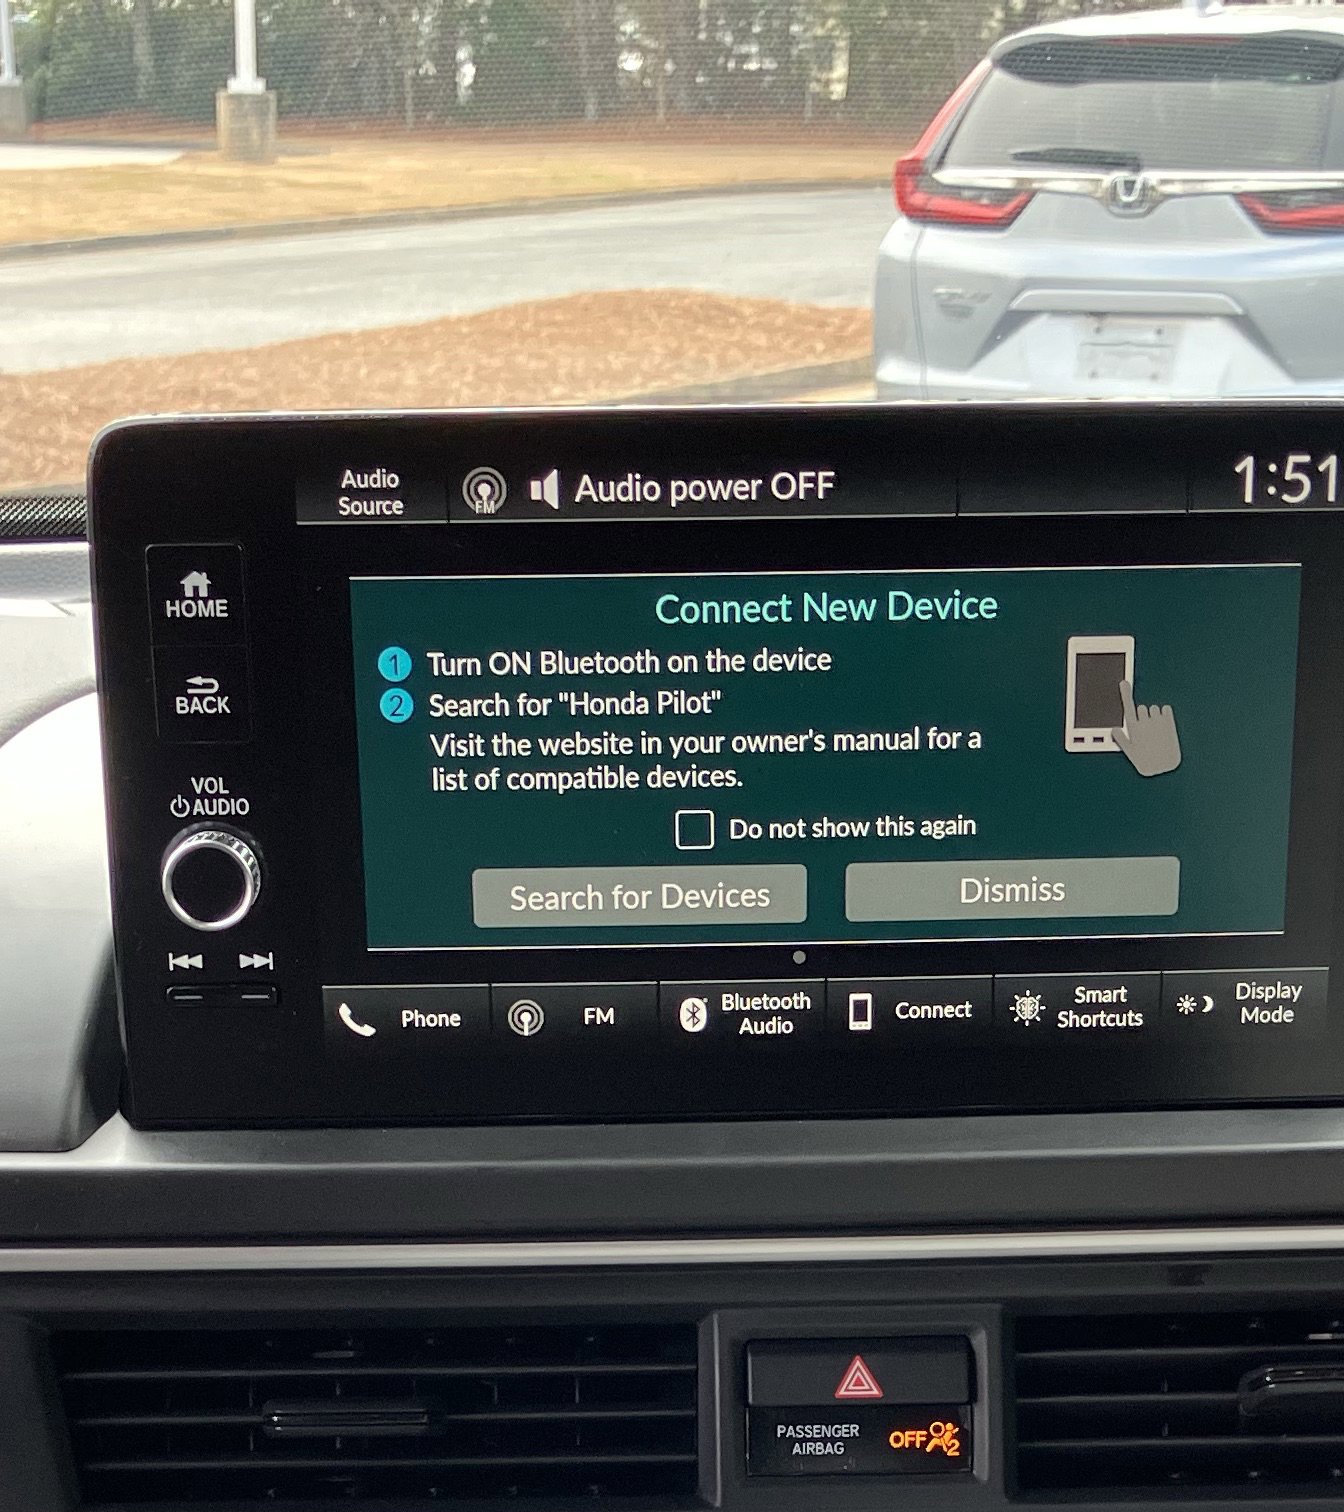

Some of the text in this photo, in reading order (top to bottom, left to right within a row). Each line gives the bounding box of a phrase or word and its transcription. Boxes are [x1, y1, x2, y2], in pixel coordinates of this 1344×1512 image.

[341, 468, 400, 489] Audio
[1234, 454, 1338, 504] 1:51
[574, 471, 836, 508] Audio power OFF
[338, 496, 404, 516] Source
[475, 500, 496, 514] FM
[165, 595, 229, 618] HOME
[655, 588, 998, 624] Connect New Device
[426, 652, 482, 677] Turn
[488, 650, 532, 676] ON
[540, 648, 660, 675] Bluetooth
[667, 654, 699, 673] on
[705, 647, 746, 673] the
[752, 646, 832, 672] device
[175, 695, 231, 715] BACK
[429, 691, 510, 718] Search
[516, 692, 553, 717] for
[558, 689, 650, 716] "Honda
[657, 689, 722, 715] Pilot"
[429, 725, 982, 760] Visit the website in your owner's manual for a
[190, 776, 230, 795] VOL
[432, 763, 744, 795] list of compatible devices.
[192, 797, 250, 816] AUDIO
[729, 814, 977, 840] Do not show this again
[510, 881, 771, 911] Search for Devices
[960, 875, 1066, 904] Dismiss
[721, 991, 811, 1012] Bluetooth
[1074, 985, 1128, 1004] Smart
[1235, 980, 1303, 1003] Display
[401, 1008, 462, 1028] Phone
[584, 1006, 615, 1025] FM
[895, 1000, 973, 1020] Connect
[1057, 1009, 1144, 1029] Shortcuts
[1240, 1004, 1295, 1024] Mode
[738, 1015, 794, 1035] Audio
[776, 1423, 860, 1439] PASSENGER
[889, 1430, 928, 1449] OFF
[791, 1441, 845, 1456] AIRBAG
